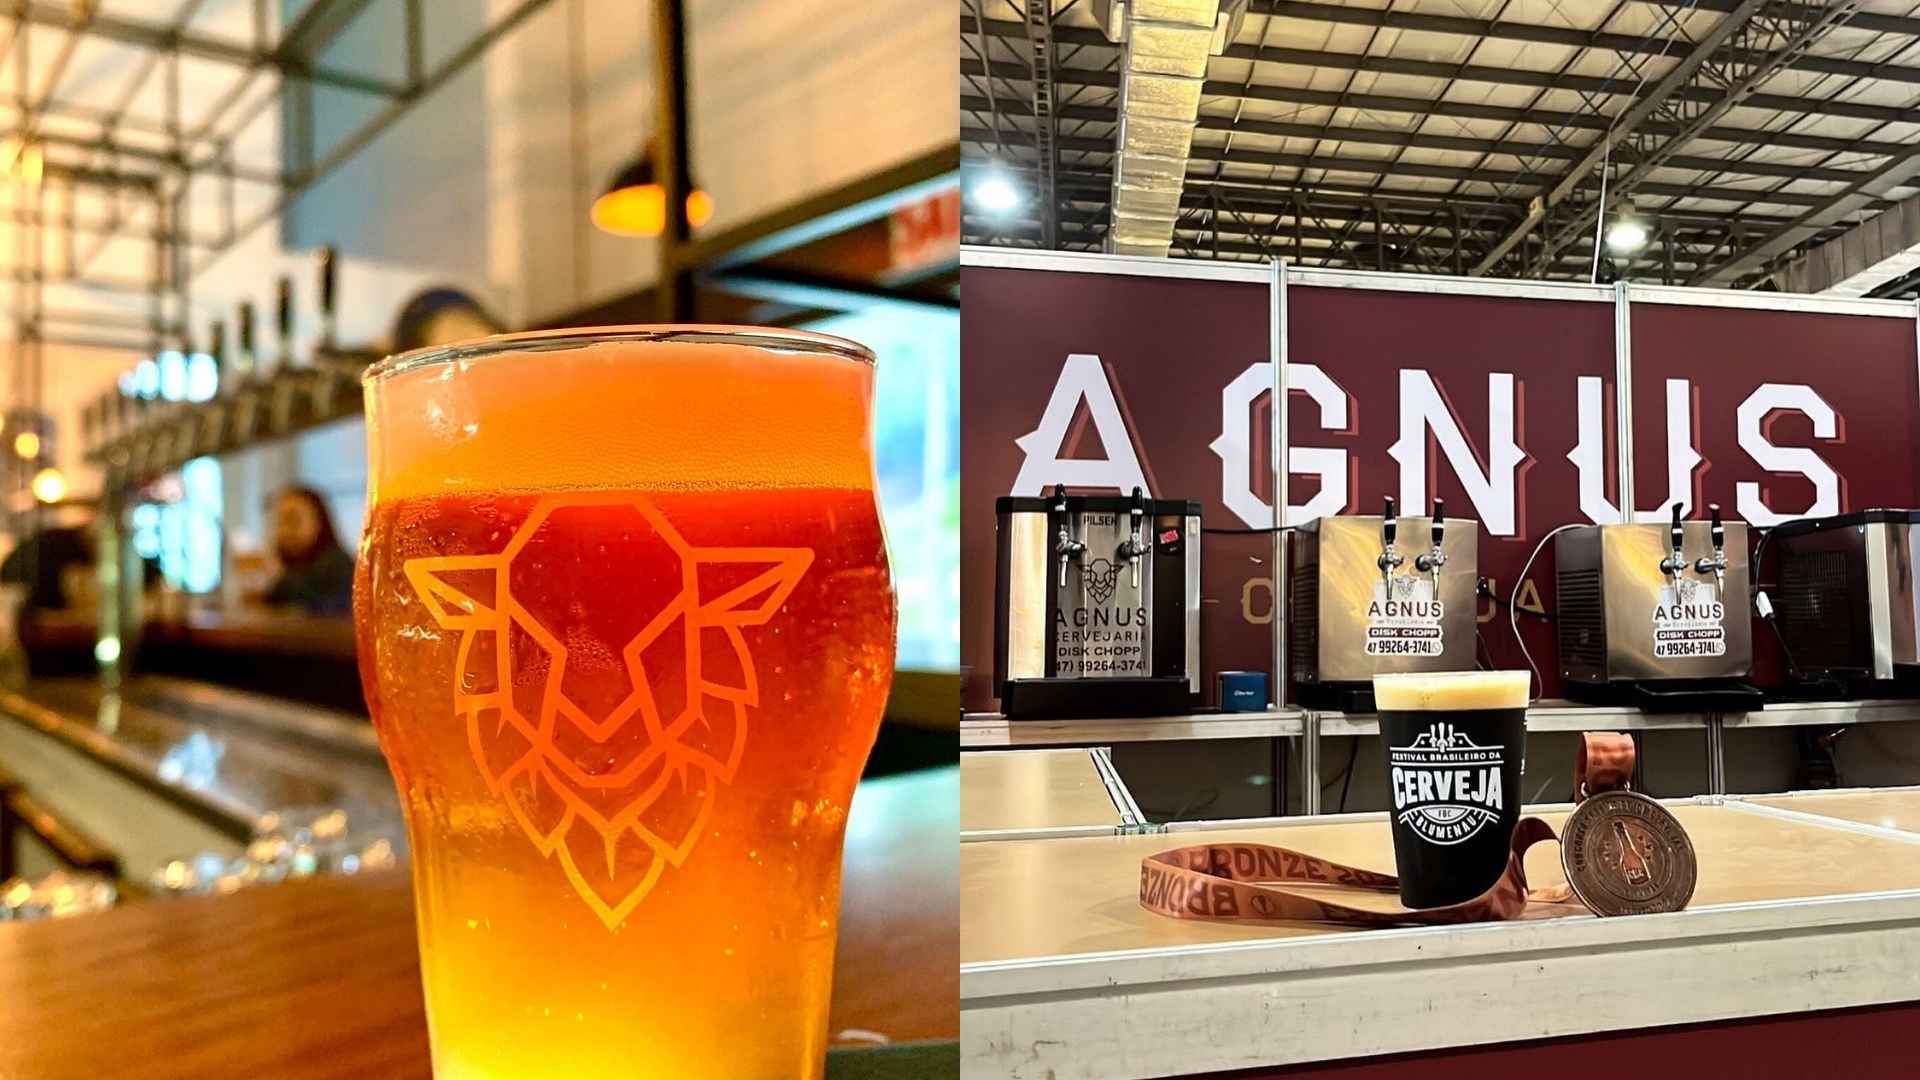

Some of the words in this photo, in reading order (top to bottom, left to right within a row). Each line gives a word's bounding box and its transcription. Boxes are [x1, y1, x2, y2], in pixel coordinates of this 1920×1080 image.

[1010, 353, 1847, 536] AGNUS
[1056, 607, 1147, 627] AGNUS
[1368, 601, 1441, 617] AGNUS
[1654, 603, 1722, 620] AGNUS
[1371, 628, 1398, 636] DISK
[1401, 628, 1437, 637] CHOPP
[1659, 631, 1684, 639] DISK
[1687, 630, 1720, 638] CHOPP
[1059, 647, 1090, 656] DISK
[1094, 646, 1140, 656] CHOPP
[1367, 642, 1377, 653] 47
[1379, 640, 1431, 653] 99264-3741
[1656, 645, 1665, 655] 47
[1667, 641, 1715, 655] 99264-3741
[1392, 752, 1427, 761] FESTIVAL
[1429, 752, 1487, 761] BRASILEIRO
[1488, 751, 1501, 759] DA
[1392, 766, 1503, 810] CERVEJA
[1415, 814, 1477, 839] BLUMENAU
[1189, 847, 1328, 881] BRONZE
